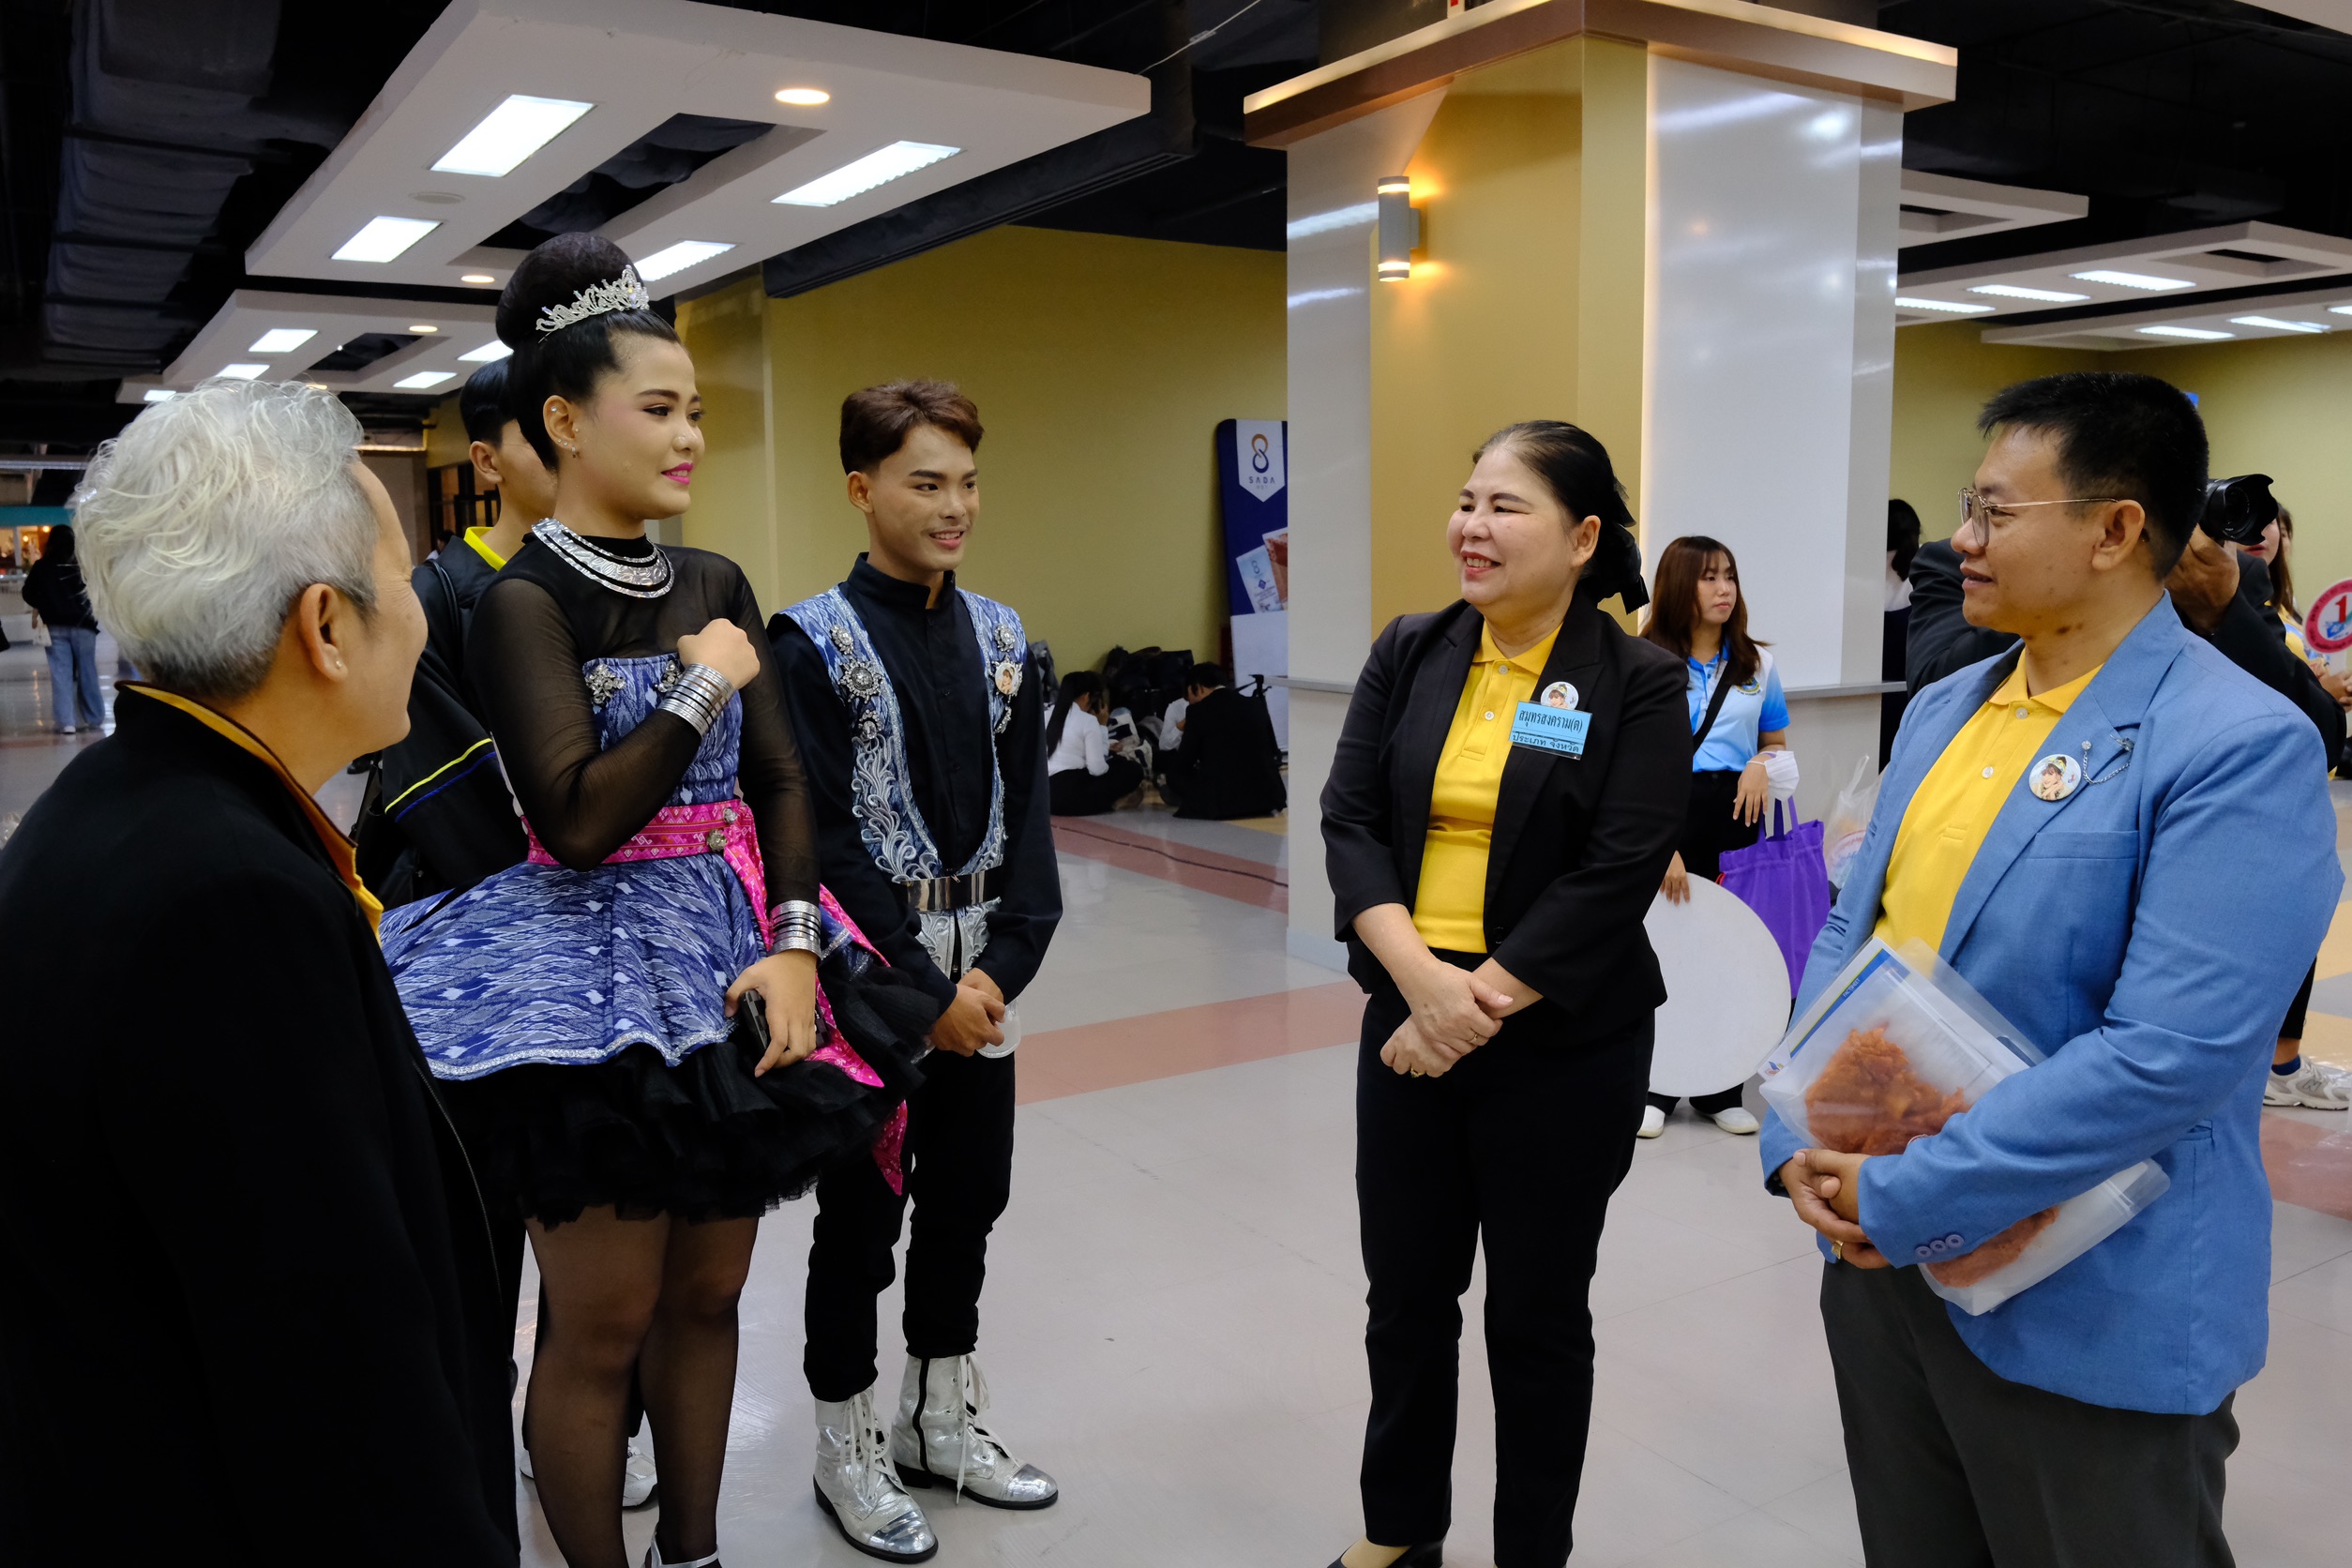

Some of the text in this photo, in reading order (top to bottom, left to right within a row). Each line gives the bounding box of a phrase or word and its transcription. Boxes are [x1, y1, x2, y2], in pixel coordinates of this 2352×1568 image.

[2335, 595, 2347, 624] 1
[1513, 732, 1579, 753] ประเภท จังหวัด
